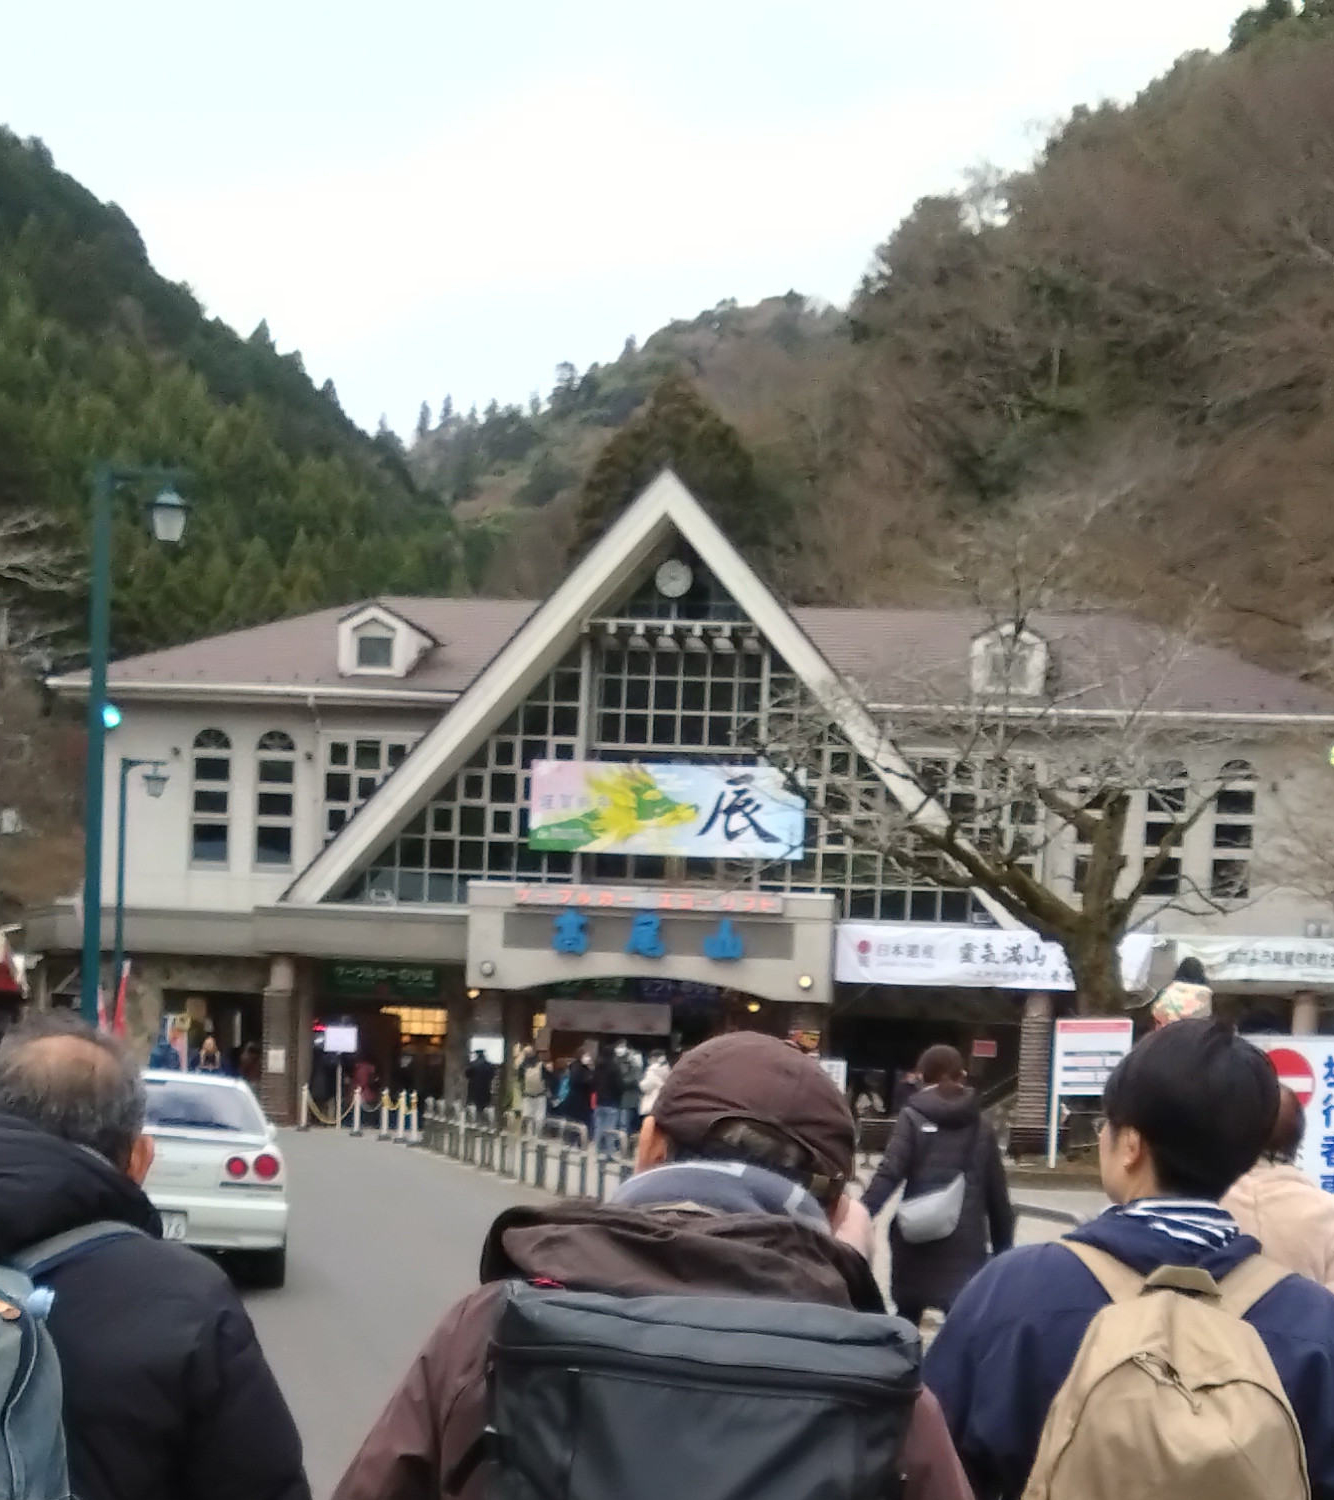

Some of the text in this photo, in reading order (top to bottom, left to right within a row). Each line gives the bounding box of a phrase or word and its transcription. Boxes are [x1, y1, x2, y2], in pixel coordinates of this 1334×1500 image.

[697, 774, 782, 843] 辰
[552, 907, 745, 960] 高尾山
